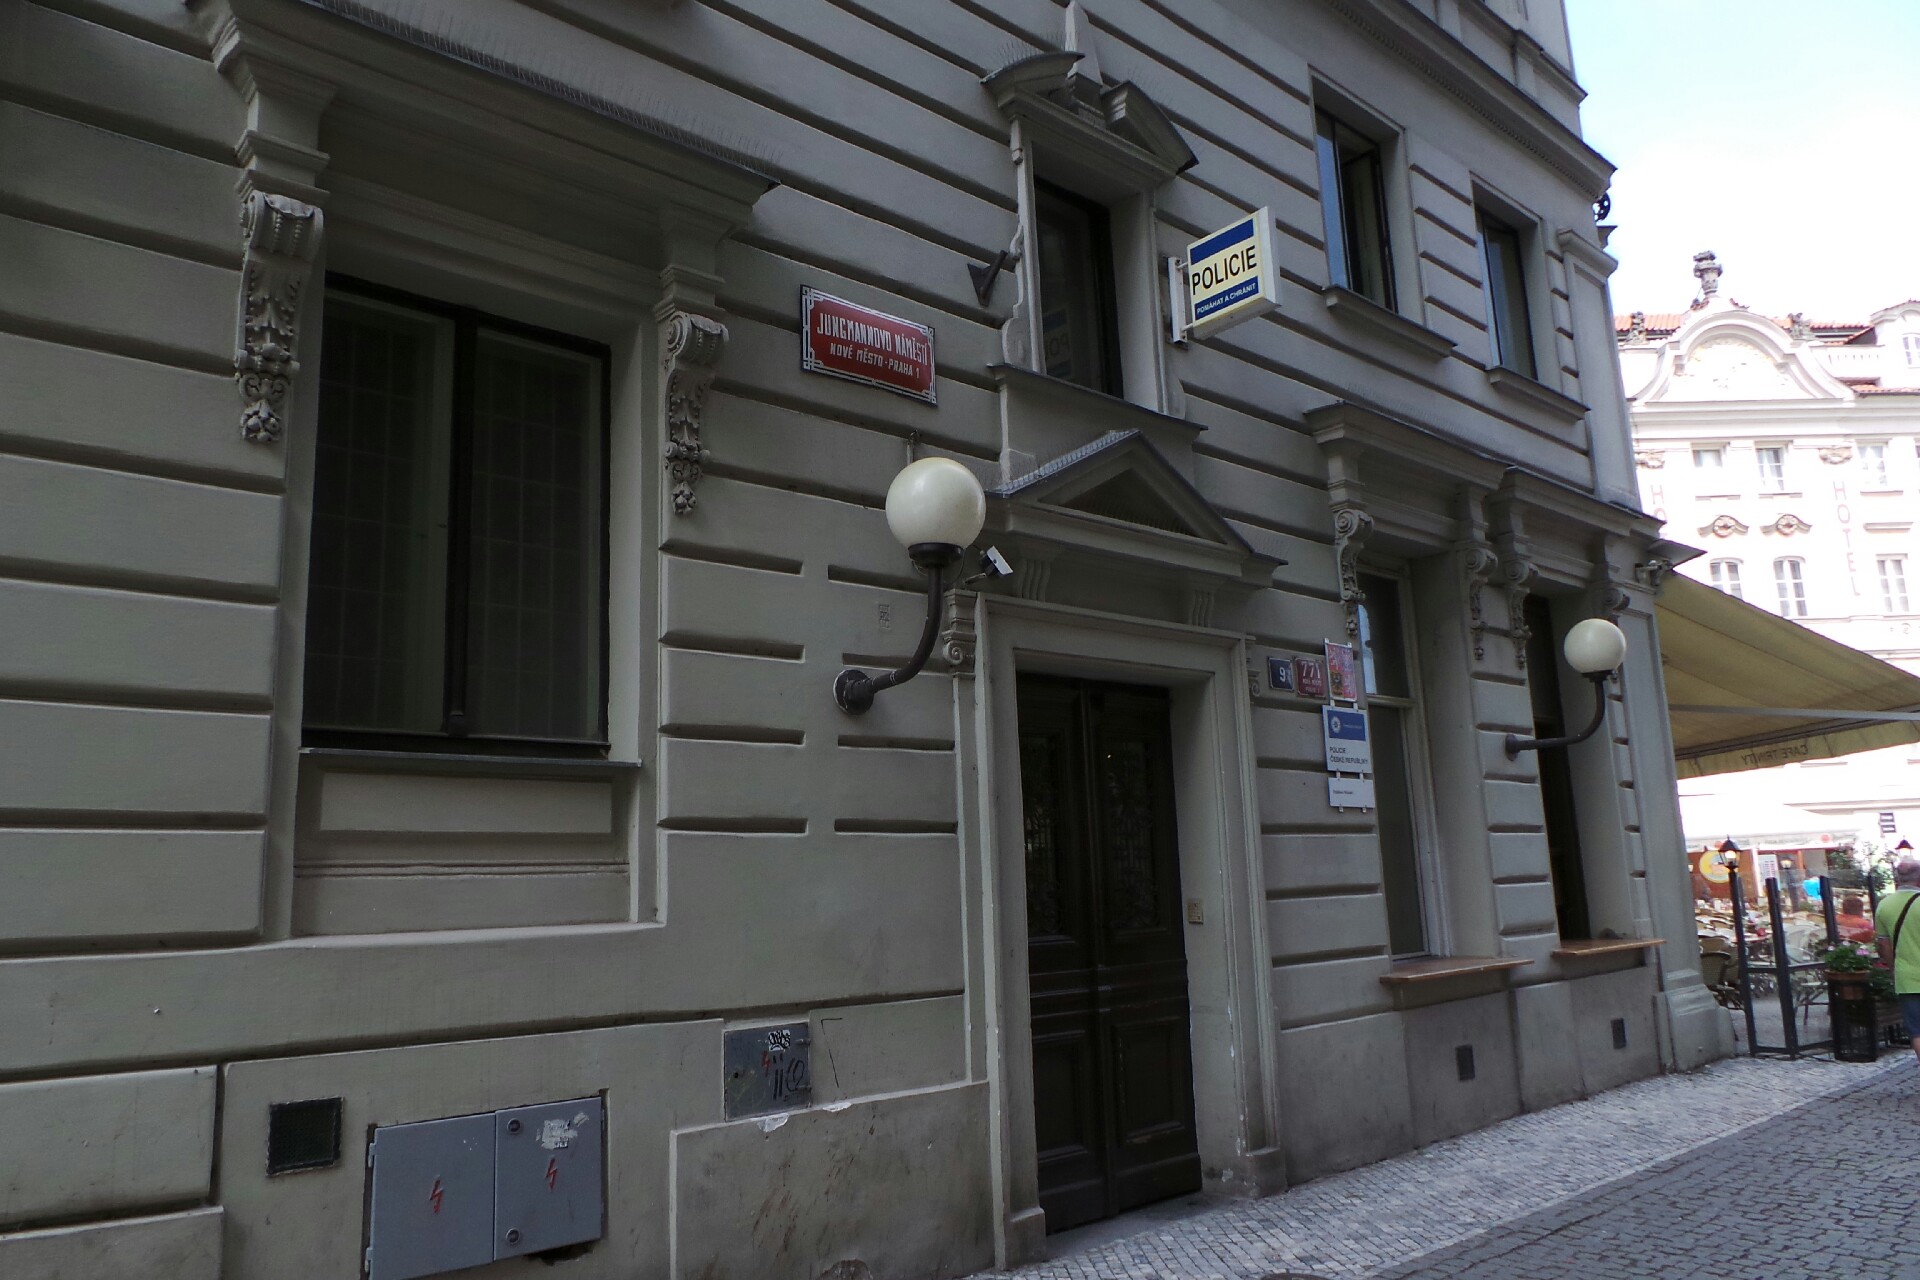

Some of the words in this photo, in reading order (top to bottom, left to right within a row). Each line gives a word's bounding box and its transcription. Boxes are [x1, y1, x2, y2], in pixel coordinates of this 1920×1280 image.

[1191, 245, 1257, 295] POLICIE
[1196, 297, 1224, 315] POMÁHAT
[1224, 295, 1230, 303] A
[1229, 282, 1256, 300] CHRÁNIT
[816, 312, 892, 352] JUNGMANNOVO
[894, 333, 928, 366] NÁMĚSTÍ
[830, 342, 853, 360] NOVÉ
[856, 348, 883, 368] MĚSTO
[888, 359, 913, 377] PRAHA
[915, 367, 920, 379] 1
[1832, 480, 1861, 598] HOTEL
[1279, 666, 1286, 682] 9
[1301, 661, 1321, 679] 771
[1329, 746, 1346, 754] POLICIE
